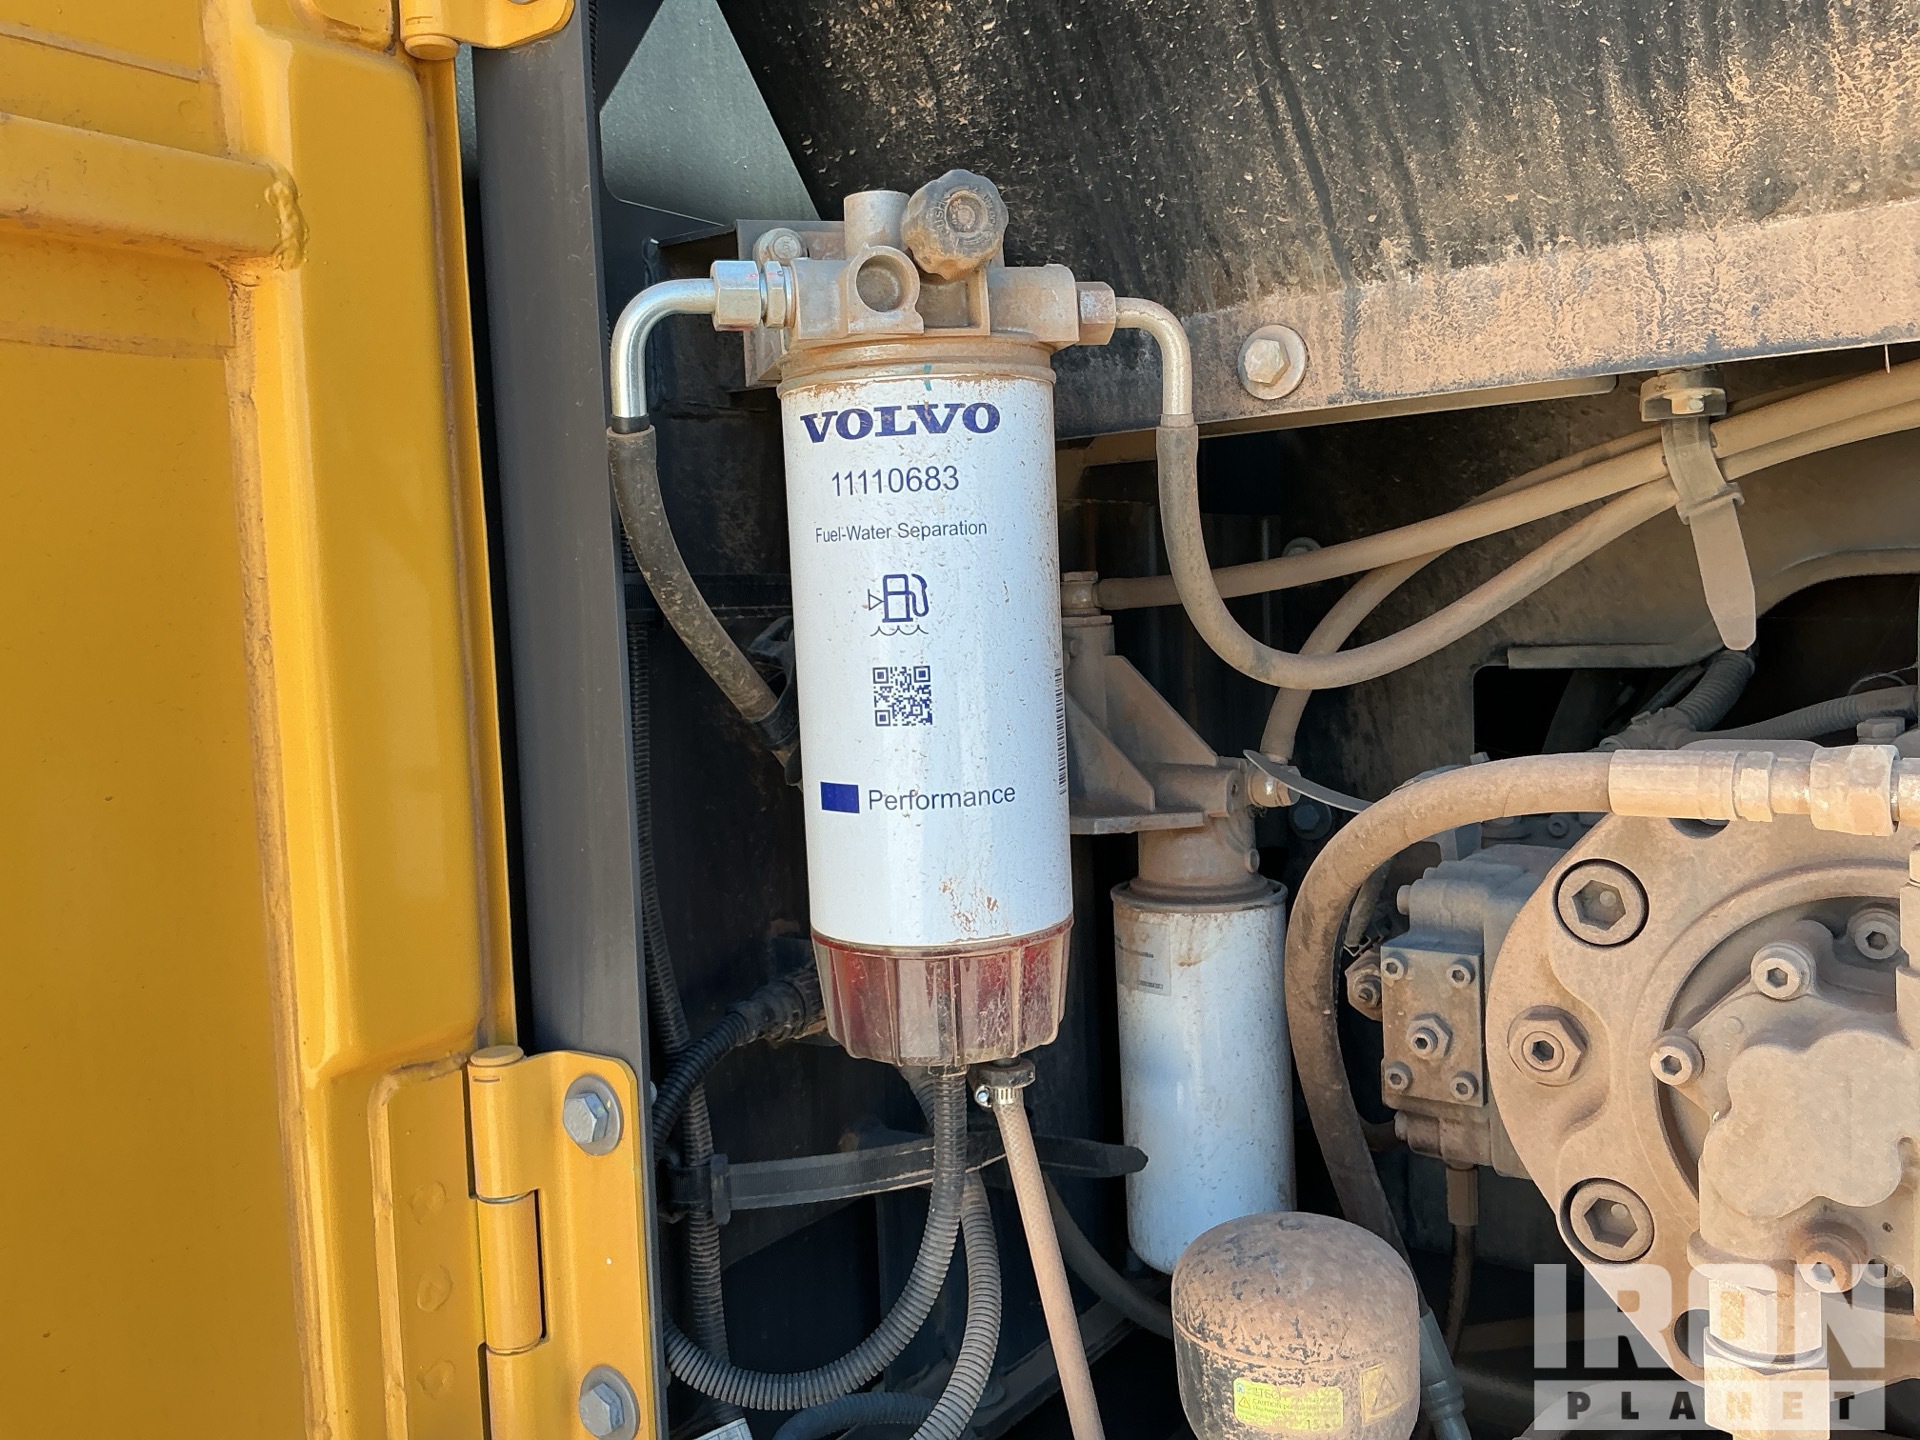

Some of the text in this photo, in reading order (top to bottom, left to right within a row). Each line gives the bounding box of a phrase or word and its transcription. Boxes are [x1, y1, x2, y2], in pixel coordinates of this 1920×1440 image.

[800, 402, 1000, 443] VOLVO
[832, 465, 960, 497] 11110683
[815, 519, 988, 543] Fuel-Water Separation
[869, 786, 1016, 811] Performance
